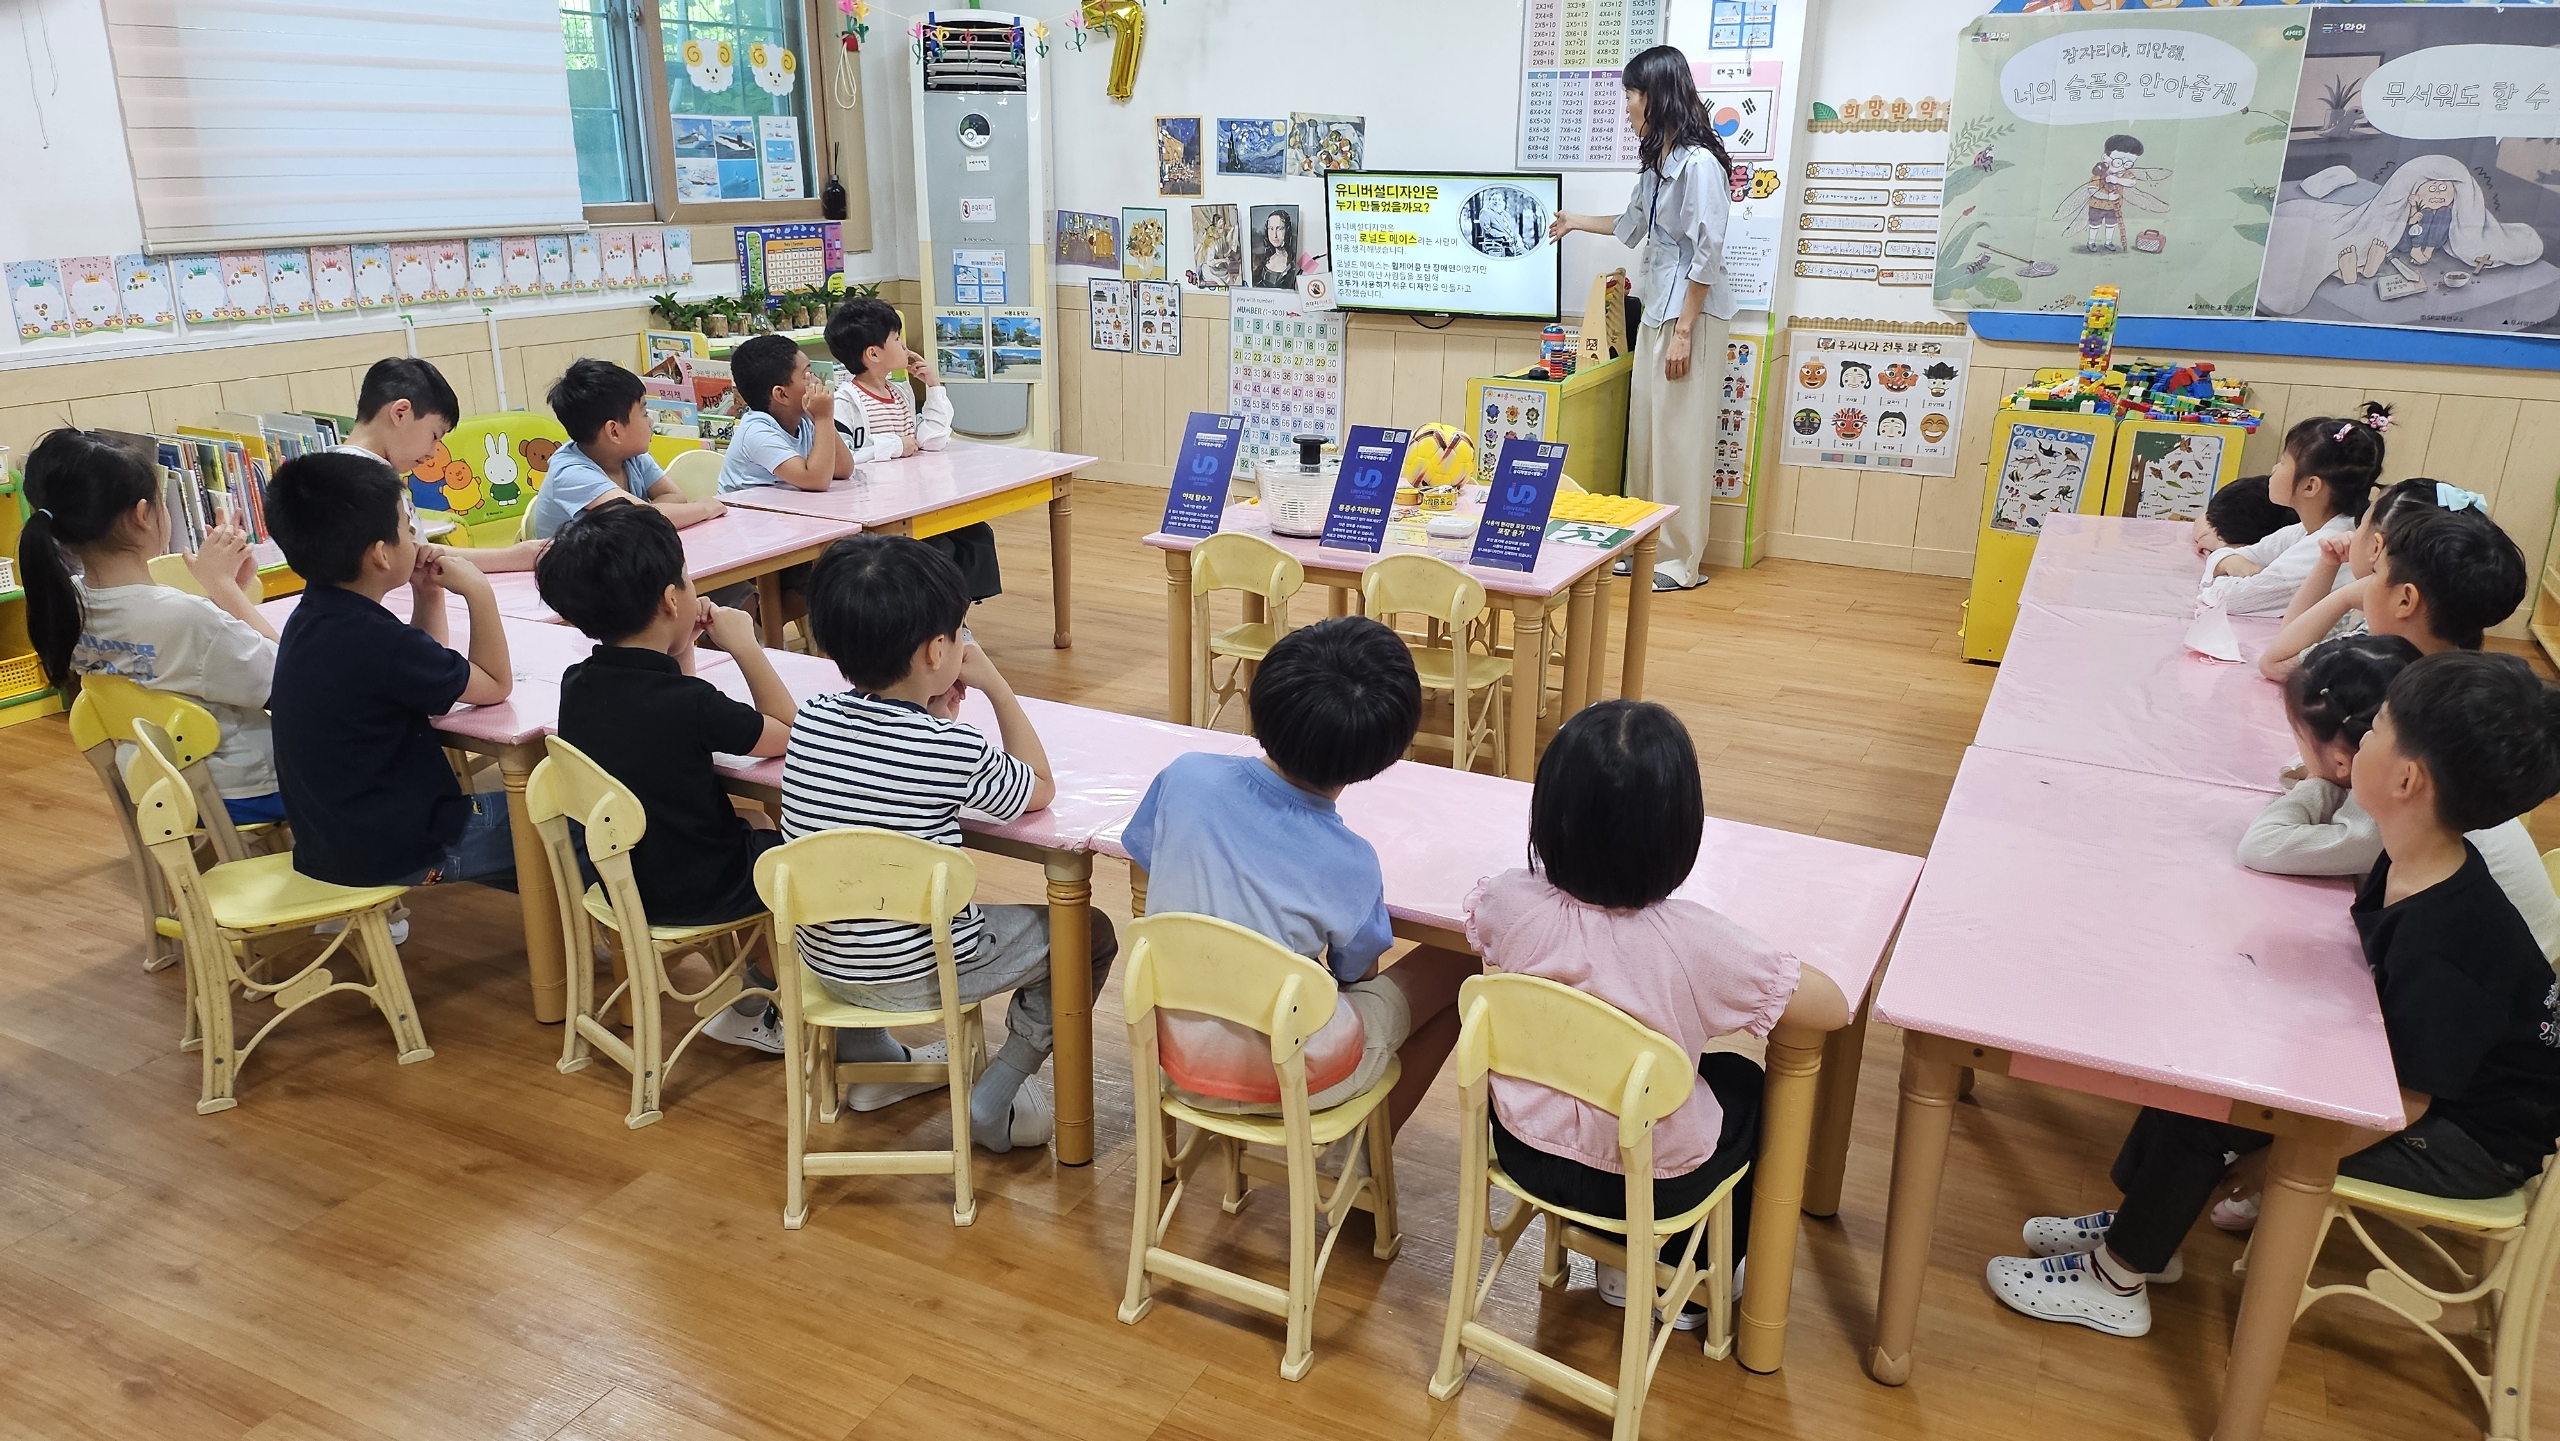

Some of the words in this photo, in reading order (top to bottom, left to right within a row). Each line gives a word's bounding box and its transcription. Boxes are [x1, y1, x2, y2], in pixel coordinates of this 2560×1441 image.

[2062, 42, 2130, 64] 잠자리야,
[2137, 42, 2185, 61] 미안해.
[1717, 68, 1745, 79] 태극기
[2014, 79, 2056, 104] 너의
[2064, 72, 2130, 101] 슬픔을
[2140, 72, 2237, 106] 안아줄게.
[2383, 82, 2480, 107] 무서워도
[2493, 82, 2519, 110] 할
[2525, 83, 2550, 110] 수
[1844, 100, 1908, 120] 희망반
[1335, 184, 1438, 199] 유니버설디자인은
[1336, 200, 1356, 211] 누가
[1360, 201, 1429, 213] 만들었을까요?
[1335, 222, 1394, 232] 유니버설디자인은
[1335, 234, 1357, 242] 미국의
[1359, 234, 1386, 243] 로널드
[1389, 234, 1433, 245] 메이스라는
[1435, 238, 1458, 246] 사람이
[1335, 244, 1350, 252] 처음
[1352, 245, 1406, 254] 생각해냈습니다.
[1337, 260, 1358, 268] 로널드
[1368, 271, 1382, 279] 아닌
[1384, 272, 1414, 280] 사람들을
[1416, 273, 1438, 282] 포함해
[1361, 280, 1390, 289] 사용하기
[1393, 282, 1407, 290] 쉬운
[1409, 282, 1439, 291] 디자인을
[1338, 289, 1383, 298] 주장했습니다.
[1237, 306, 1261, 314] NUMBER
[1244, 335, 1252, 346] 12
[1263, 336, 1271, 347] 14
[1306, 340, 1314, 351] 18
[1328, 341, 1336, 352] 20
[1837, 341, 1879, 351] 우리나라
[1883, 343, 1903, 352] 전통
[1908, 343, 1918, 352] 탈
[1254, 351, 1261, 362] 23
[1273, 353, 1281, 364] 25
[1263, 367, 1270, 378] 34
[1283, 369, 1291, 380] 36
[659, 390, 681, 400] 돼지책
[1272, 384, 1280, 395] 45
[1294, 386, 1302, 397] 47
[1242, 397, 1250, 408] 52
[1282, 402, 1290, 412] 56
[1304, 403, 1312, 414] 58
[1252, 413, 1260, 424] 63
[1293, 418, 1301, 429] 67
[1315, 420, 1323, 431] 69
[1261, 430, 1269, 442] 74
[1270, 446, 1278, 457] 85
[1195, 494, 1212, 503] 탈수기
[1503, 505, 1532, 514] UNIVERSAL
[1497, 528, 1510, 536] 포장
